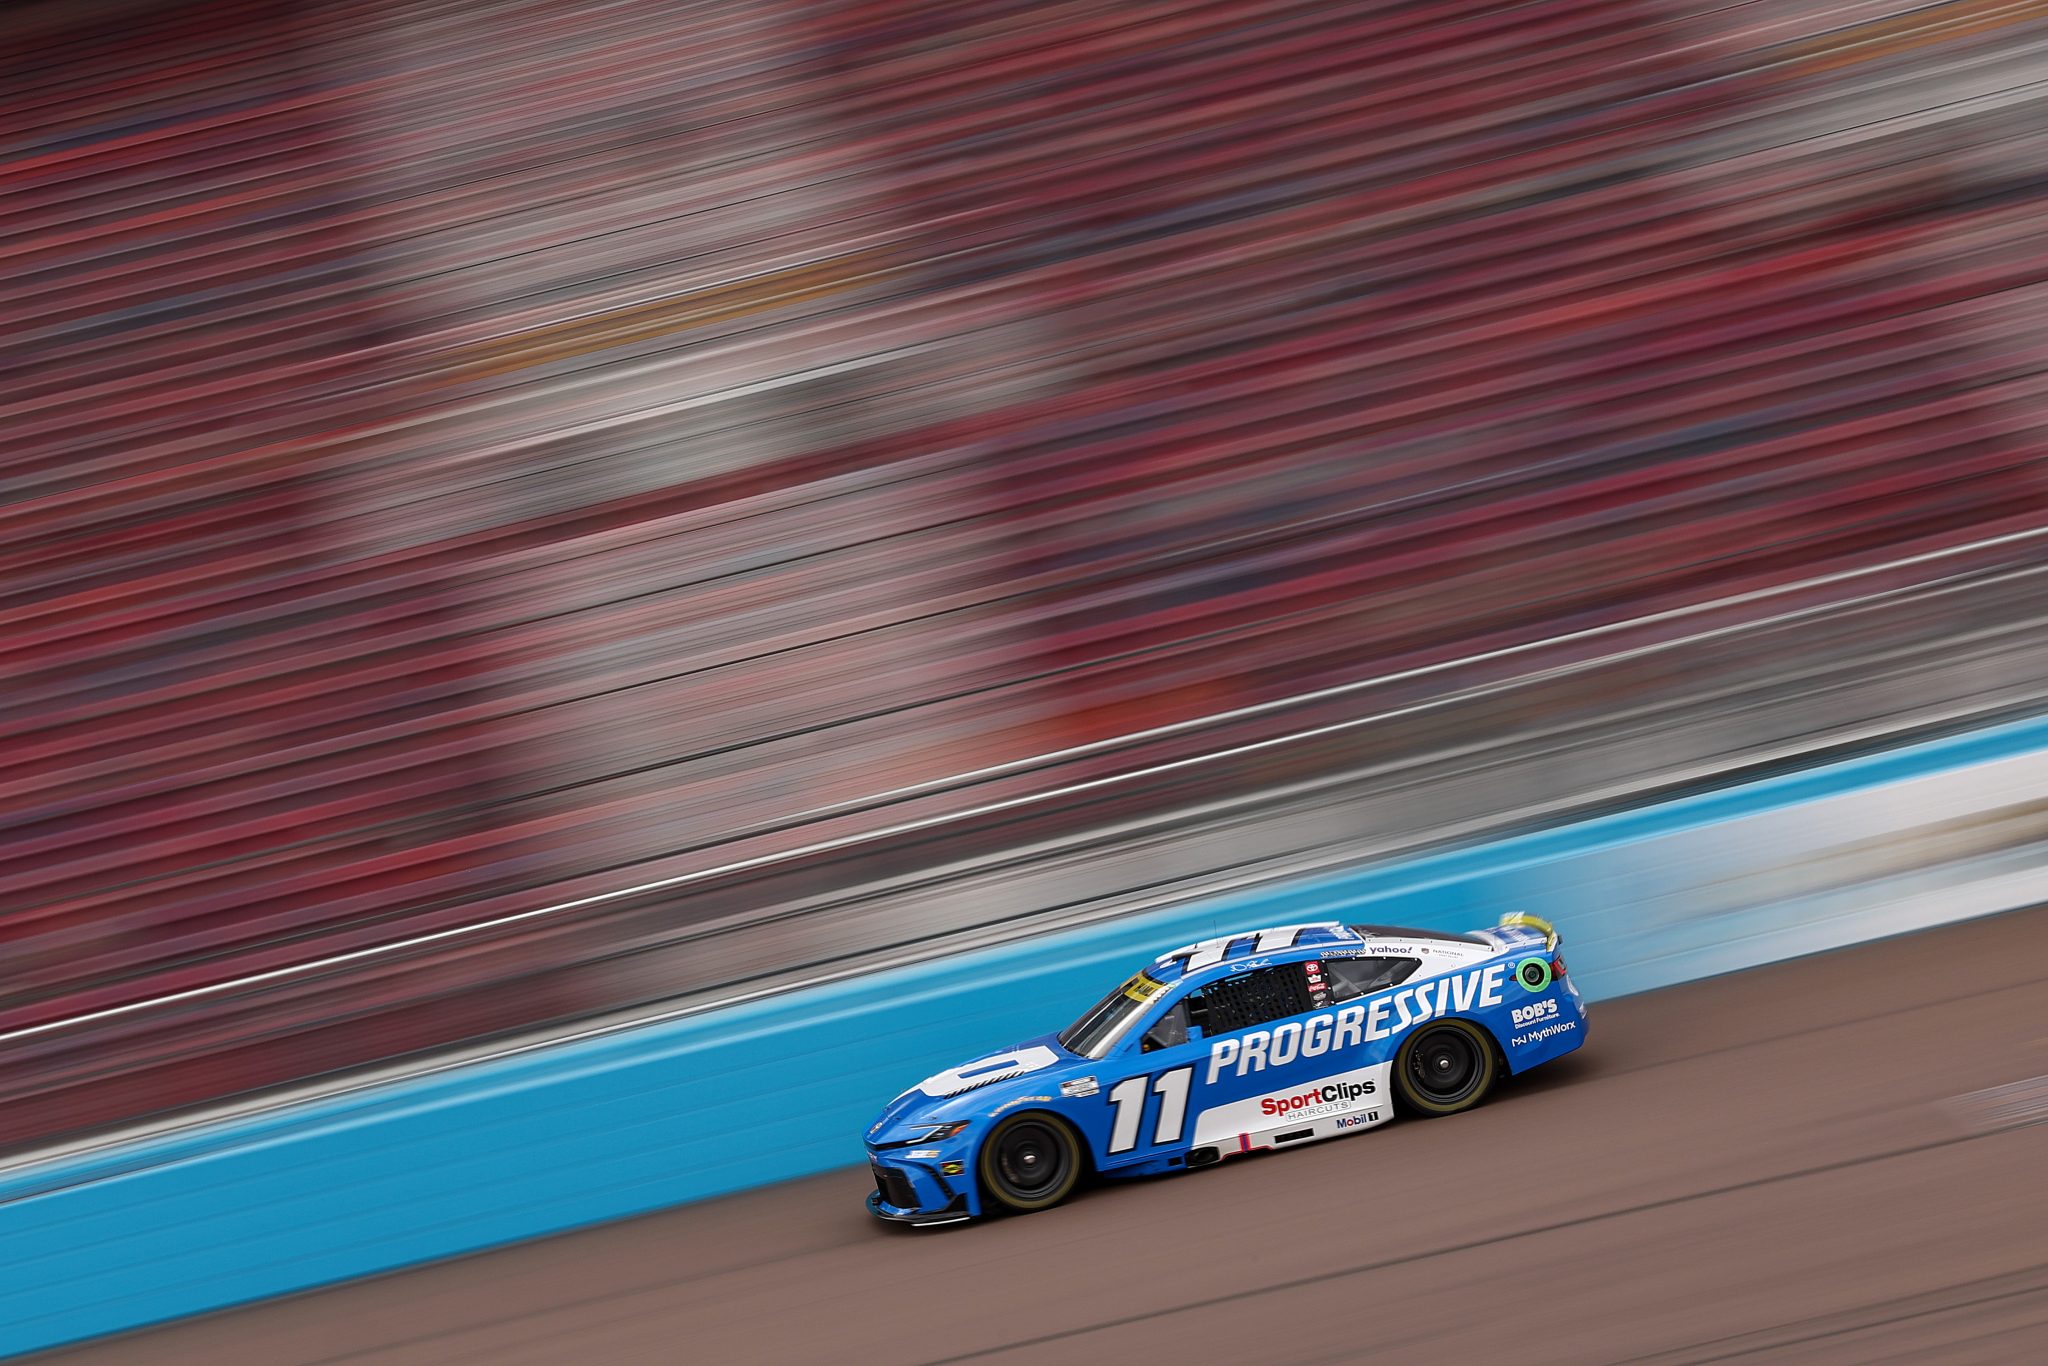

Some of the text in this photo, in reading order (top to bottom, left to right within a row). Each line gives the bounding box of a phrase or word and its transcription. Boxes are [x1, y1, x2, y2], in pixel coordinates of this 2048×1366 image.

[1370, 946, 1412, 955] yahoo!
[1511, 998, 1558, 1024] BOB'S
[1206, 963, 1505, 1084] PROGRESSIVE
[1528, 1021, 1576, 1042] MythWorx
[1261, 1080, 1377, 1116] SportClips
[1108, 1067, 1193, 1154] 11
[1288, 1101, 1349, 1120] HAIRCUTS
[1336, 1114, 1367, 1129] Mobil
